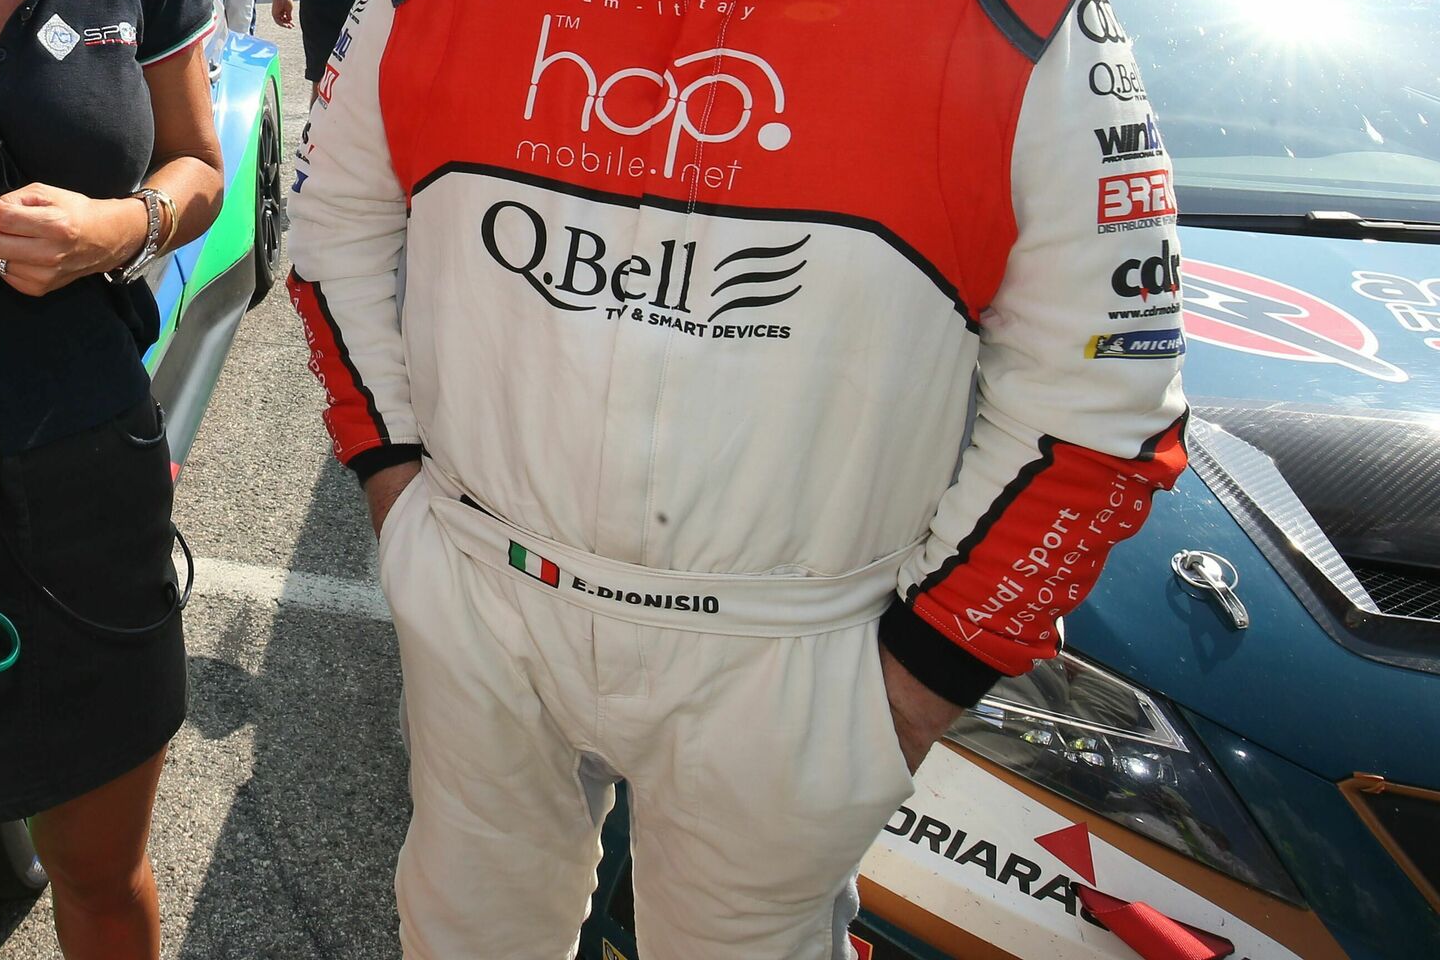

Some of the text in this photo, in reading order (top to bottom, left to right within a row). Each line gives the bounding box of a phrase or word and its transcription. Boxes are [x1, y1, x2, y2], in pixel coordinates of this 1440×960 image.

[557, 14, 581, 29] TM
[1094, 113, 1162, 157] winb
[515, 140, 744, 191] mobile.net
[481, 200, 697, 314] Q.Bell
[605, 305, 791, 340] TV & SMART DEVICES
[965, 507, 1081, 625] Audi Sport
[1004, 538, 1090, 637] ustomer
[571, 576, 720, 614] E.DIONISIO
